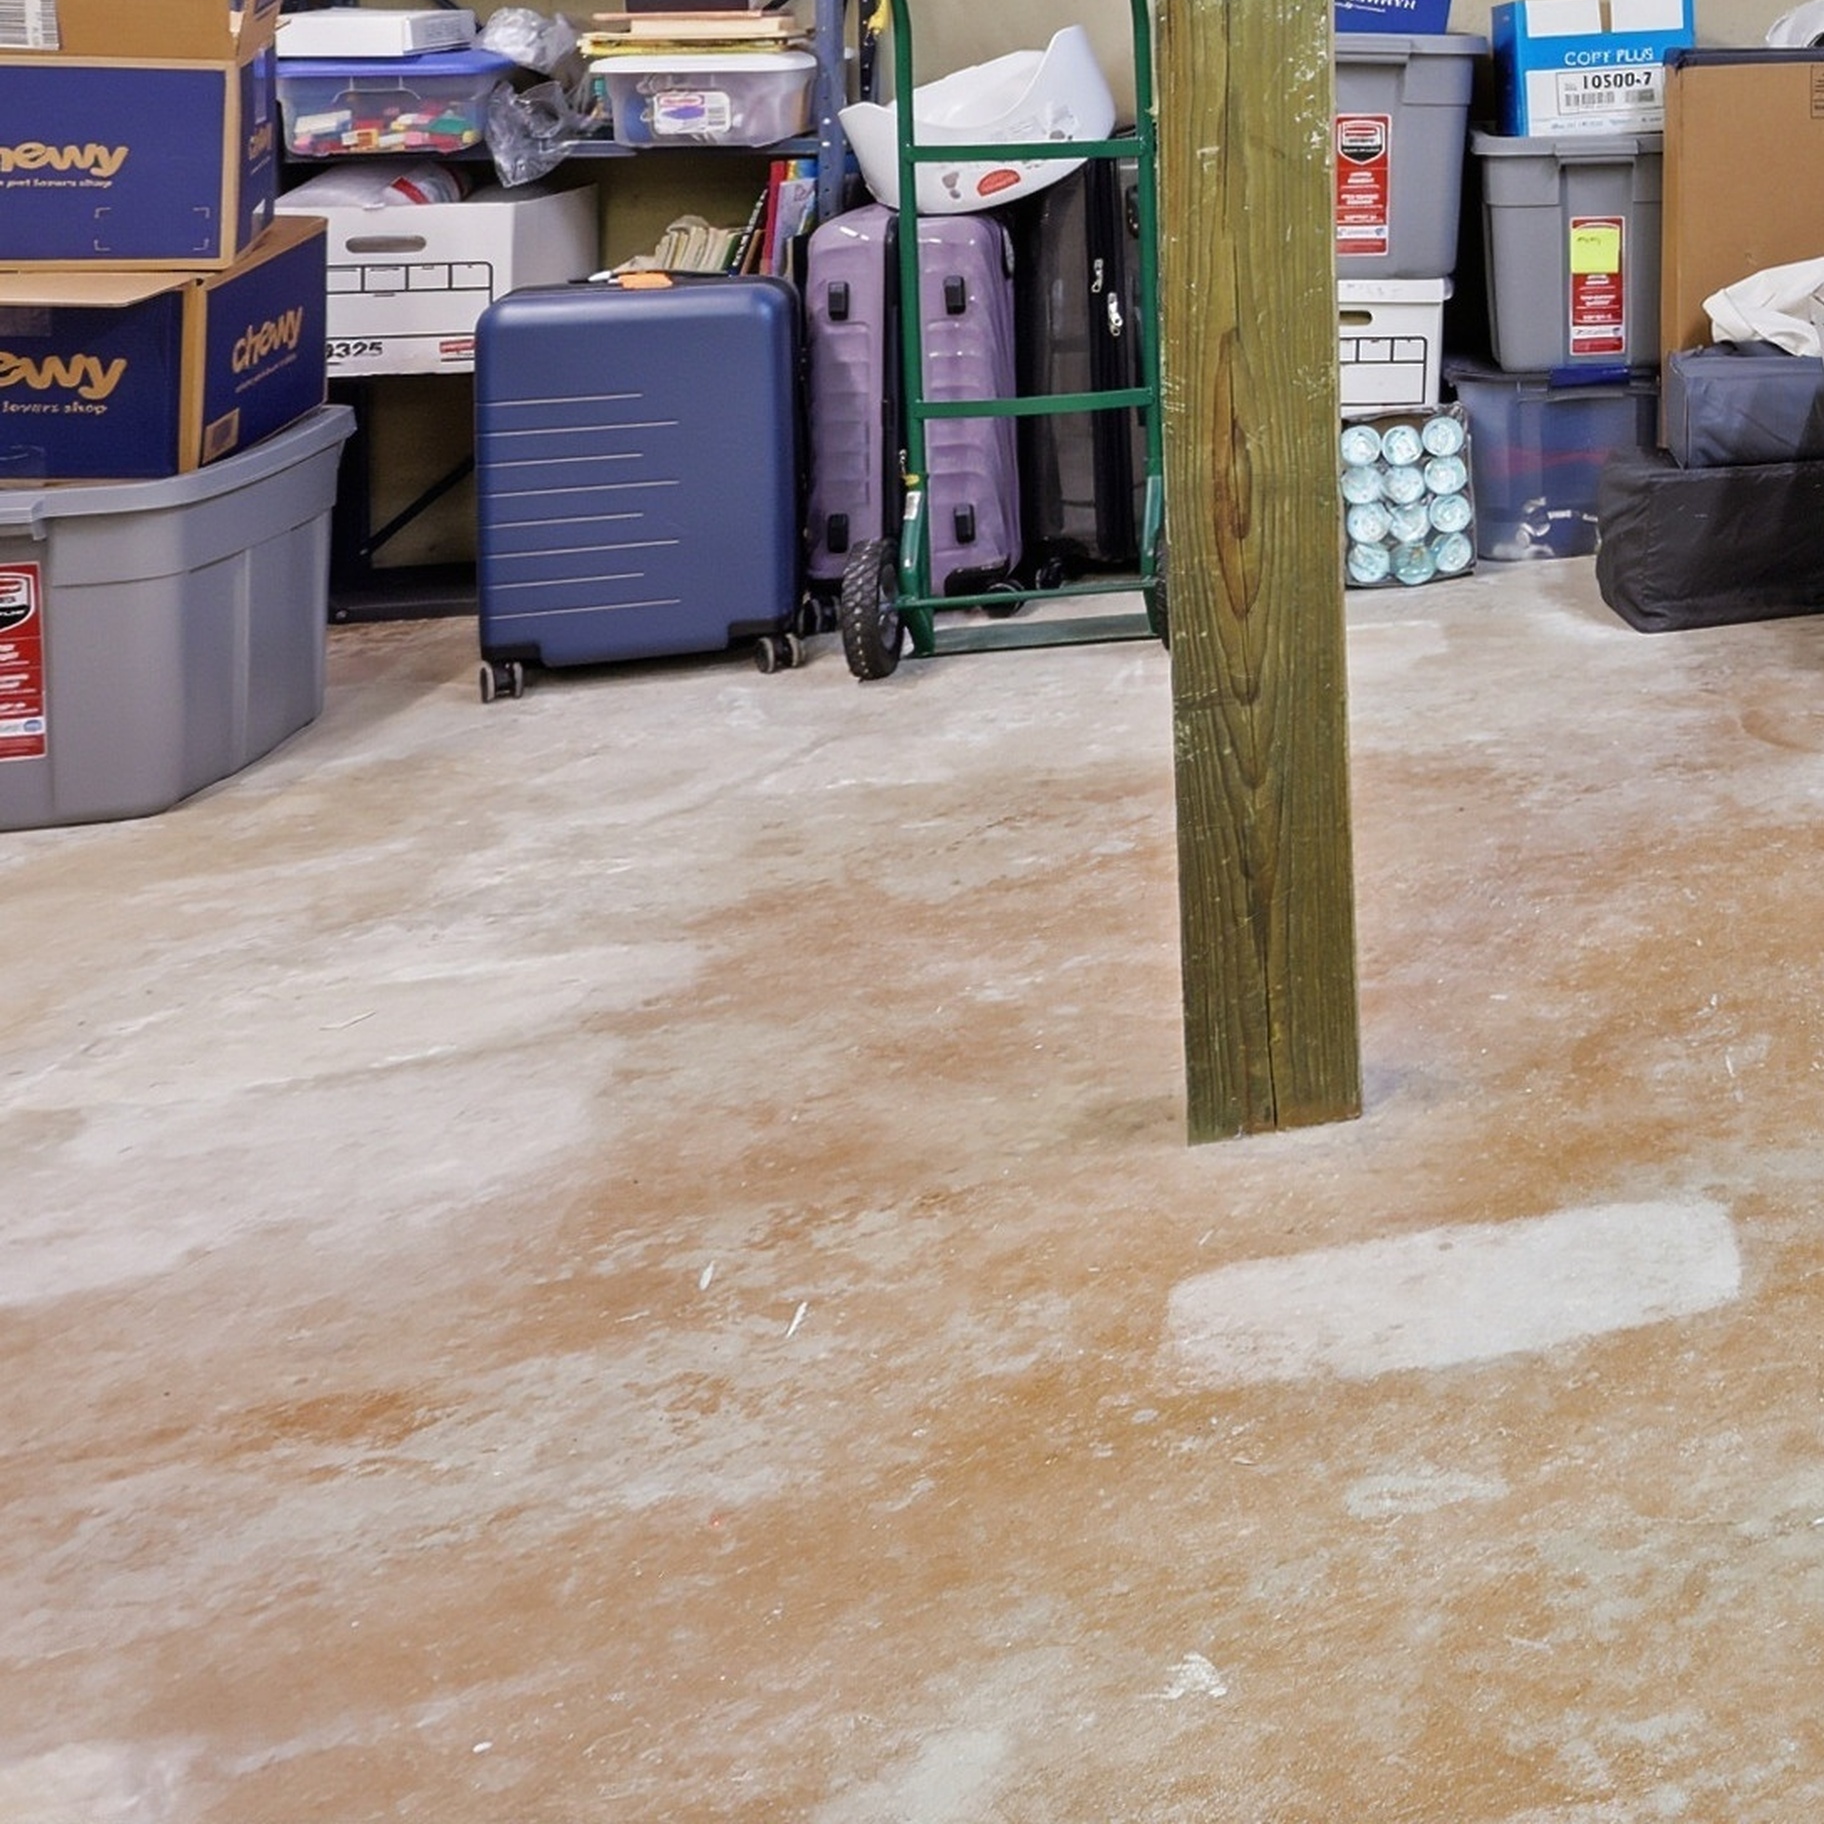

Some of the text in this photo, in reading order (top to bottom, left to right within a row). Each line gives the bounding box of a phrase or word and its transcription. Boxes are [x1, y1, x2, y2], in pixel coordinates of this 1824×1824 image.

[1564, 47, 1654, 66] COPY PLUS
[231, 306, 304, 374] chewy
